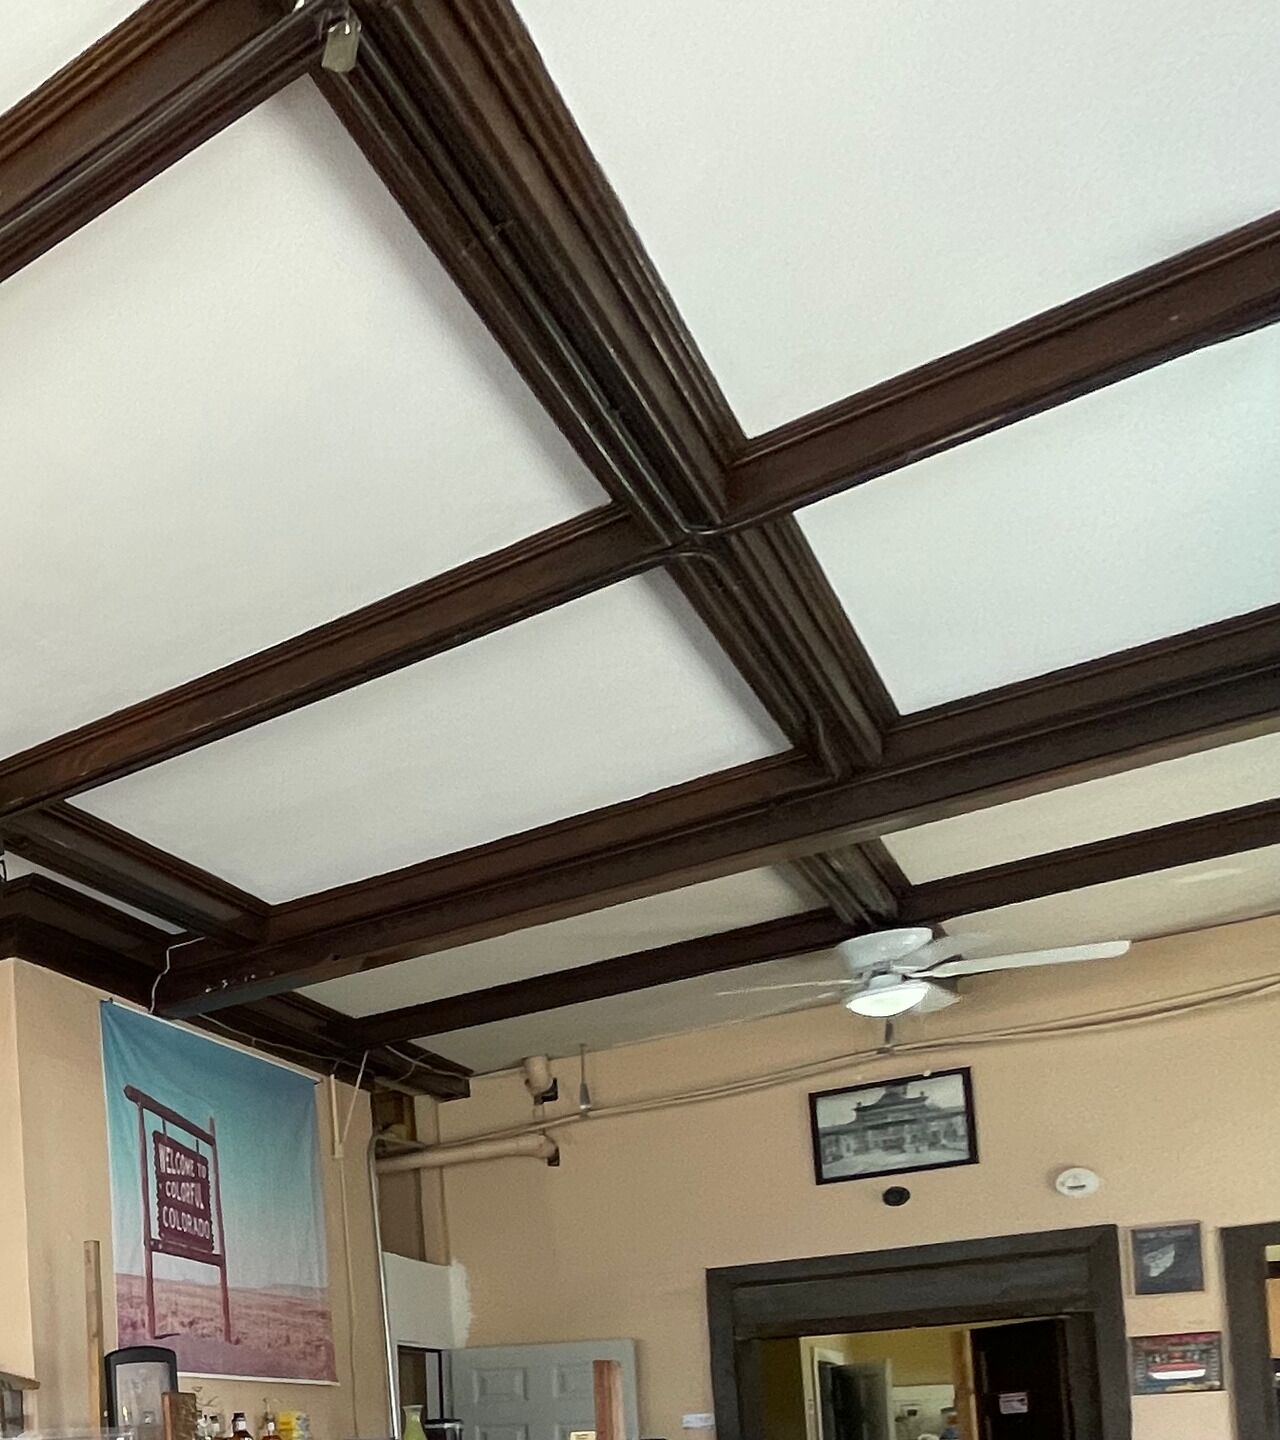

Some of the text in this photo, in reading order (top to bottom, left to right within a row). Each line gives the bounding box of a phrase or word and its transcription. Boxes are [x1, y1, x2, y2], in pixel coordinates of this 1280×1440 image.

[158, 1143, 207, 1179] WELCOME TO
[165, 1181, 205, 1210] COLORFUL
[163, 1206, 210, 1239] COLORADO
